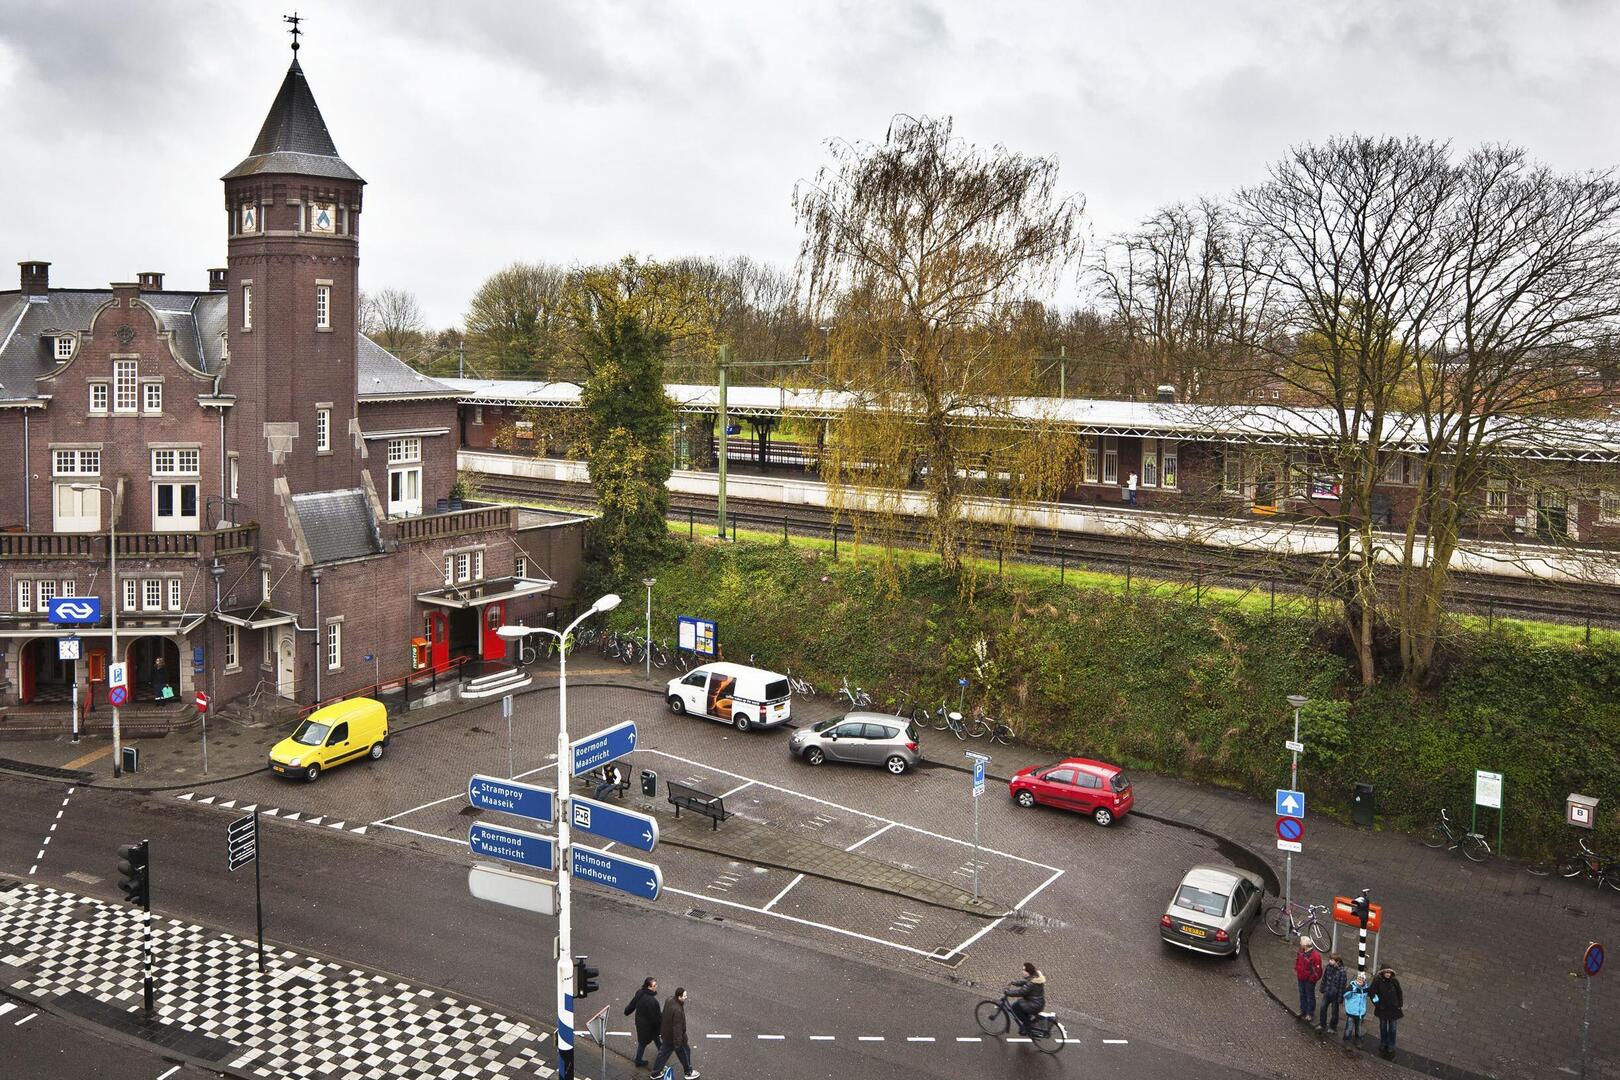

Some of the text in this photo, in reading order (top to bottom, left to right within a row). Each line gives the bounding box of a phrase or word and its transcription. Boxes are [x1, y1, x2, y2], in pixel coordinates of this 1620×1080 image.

[575, 738, 608, 757] Roermond
[575, 750, 609, 769] Maastricht
[976, 764, 983, 778] P
[481, 784, 523, 799] Stramproy
[481, 796, 514, 808] Maaseik
[481, 830, 522, 846] Roermond
[481, 842, 525, 859] Maastricht
[575, 853, 611, 869] Helmond
[575, 865, 617, 883] Eindhoven
